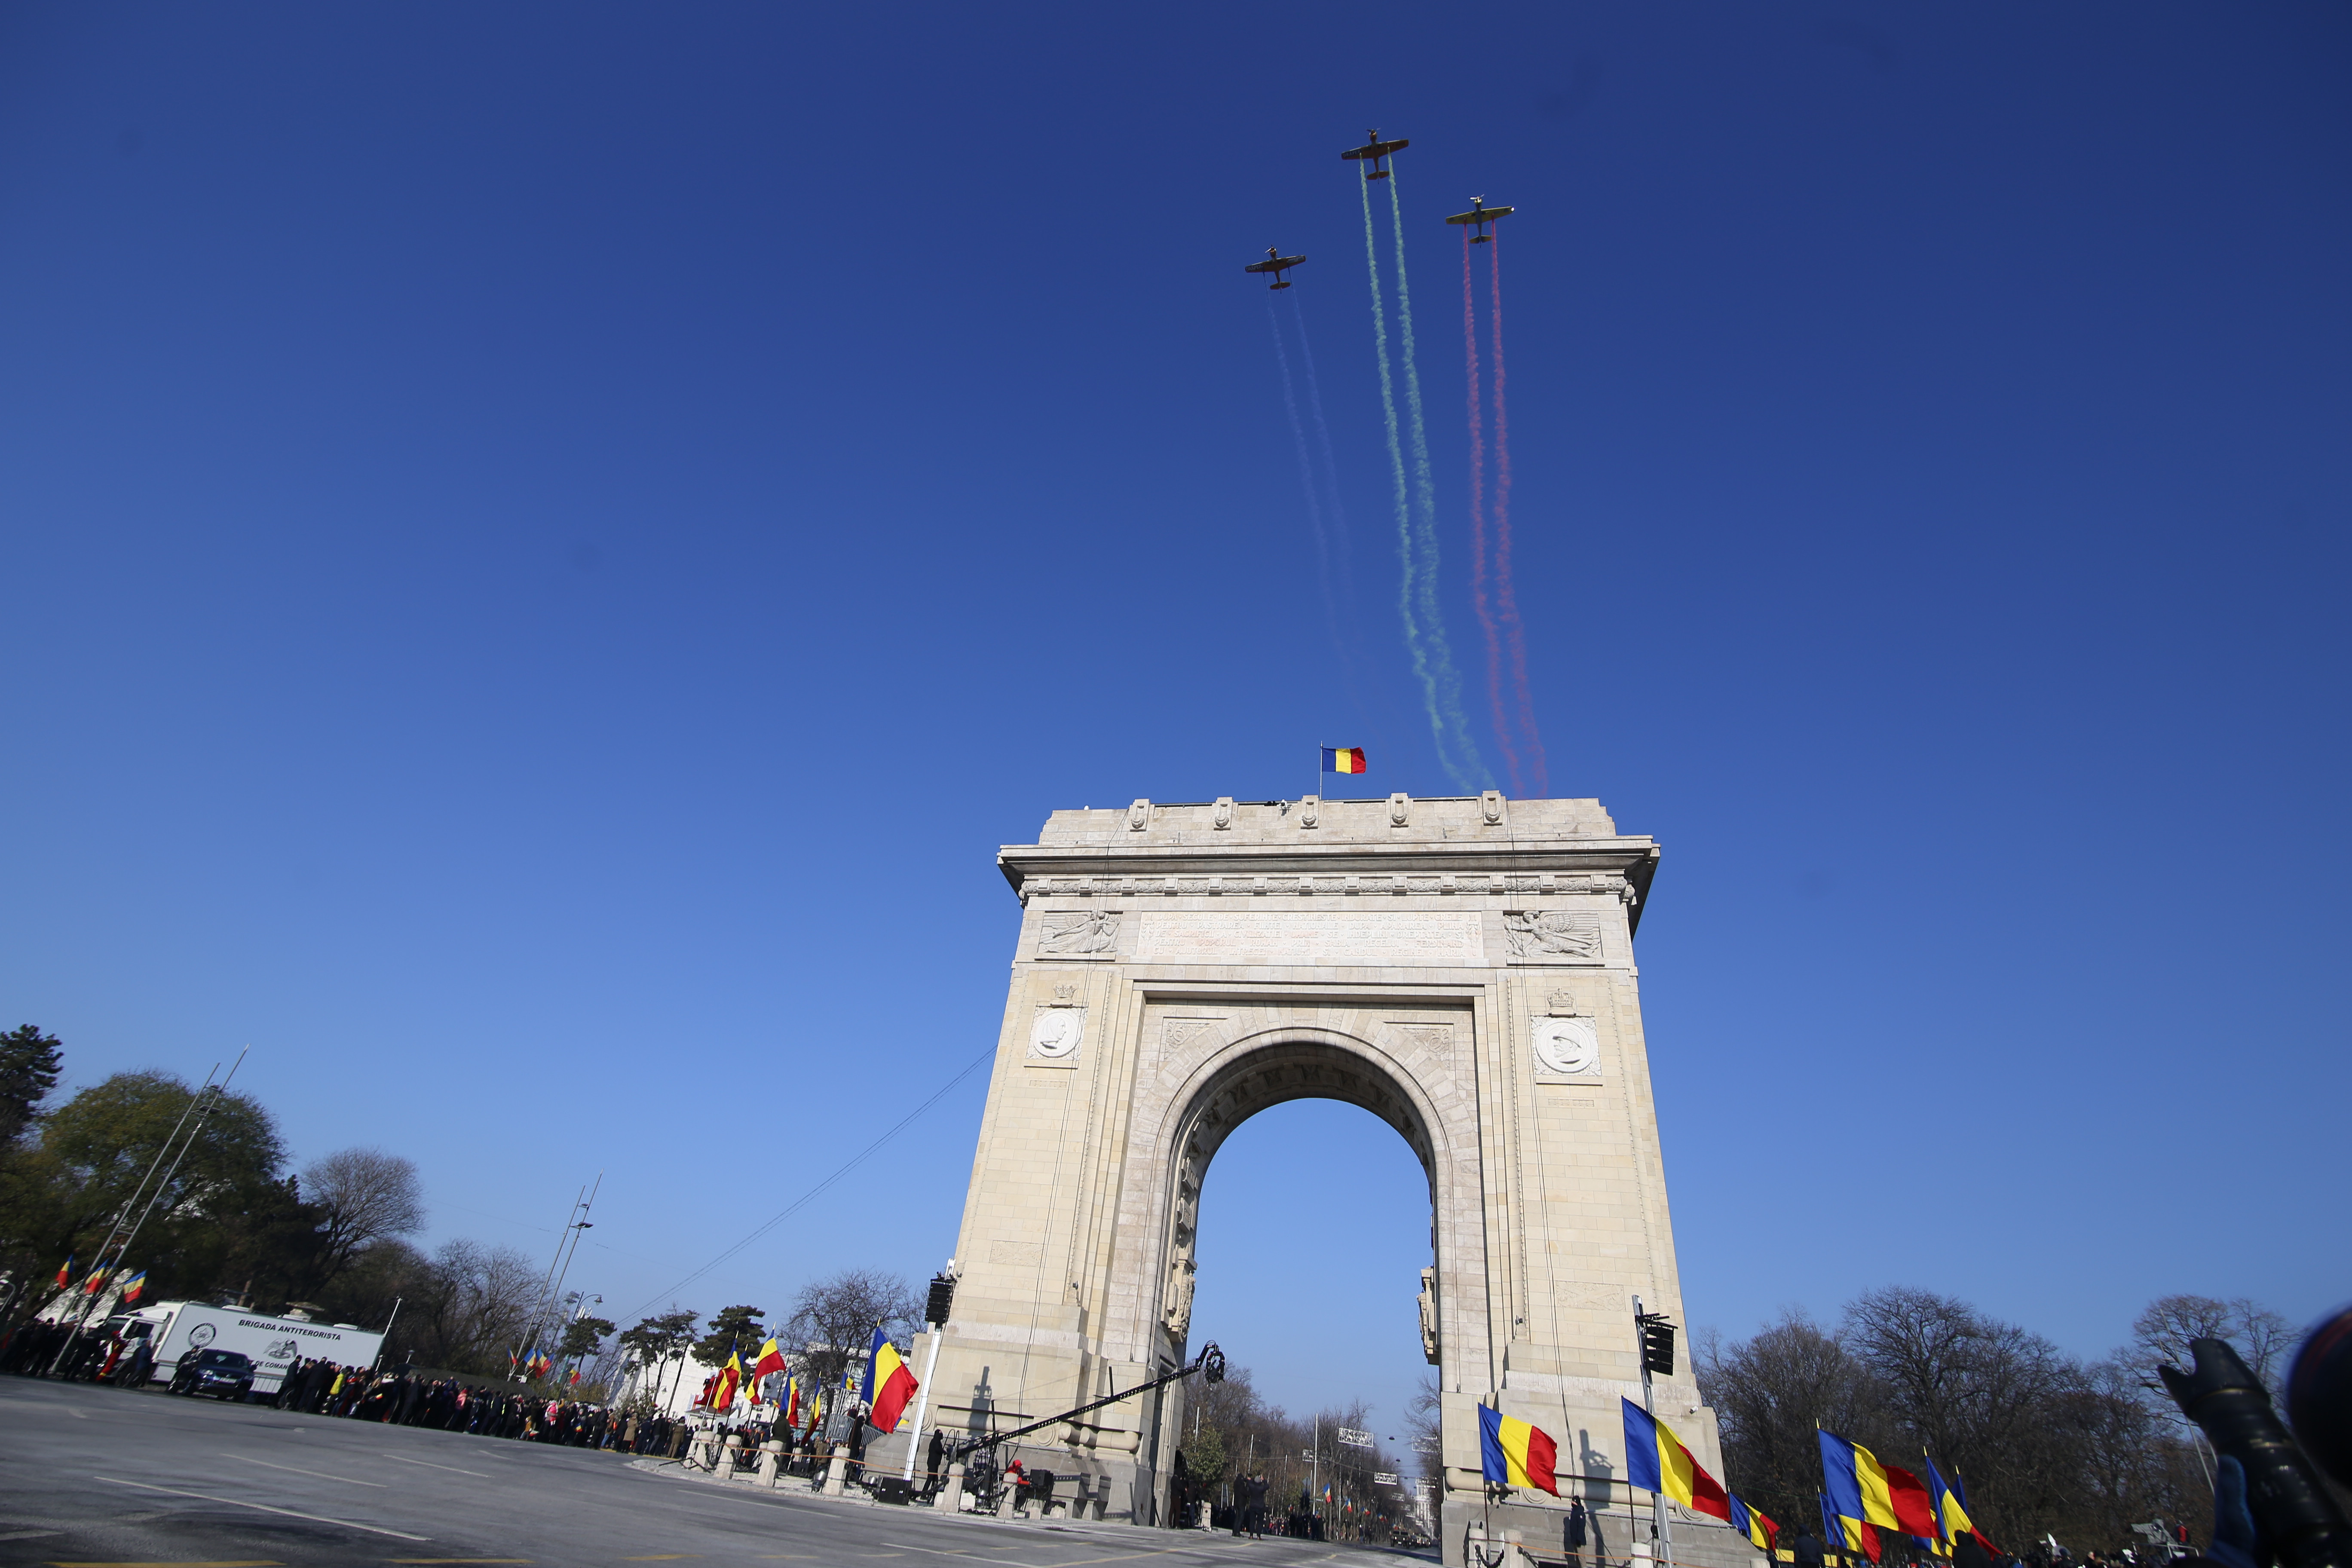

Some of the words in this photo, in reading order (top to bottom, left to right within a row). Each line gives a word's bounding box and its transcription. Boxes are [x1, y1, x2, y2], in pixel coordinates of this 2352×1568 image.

[238, 1319, 276, 1331] BRIGADA
[278, 1326, 341, 1341] ANTITERORISTA
[264, 1361, 288, 1370] COMAN
